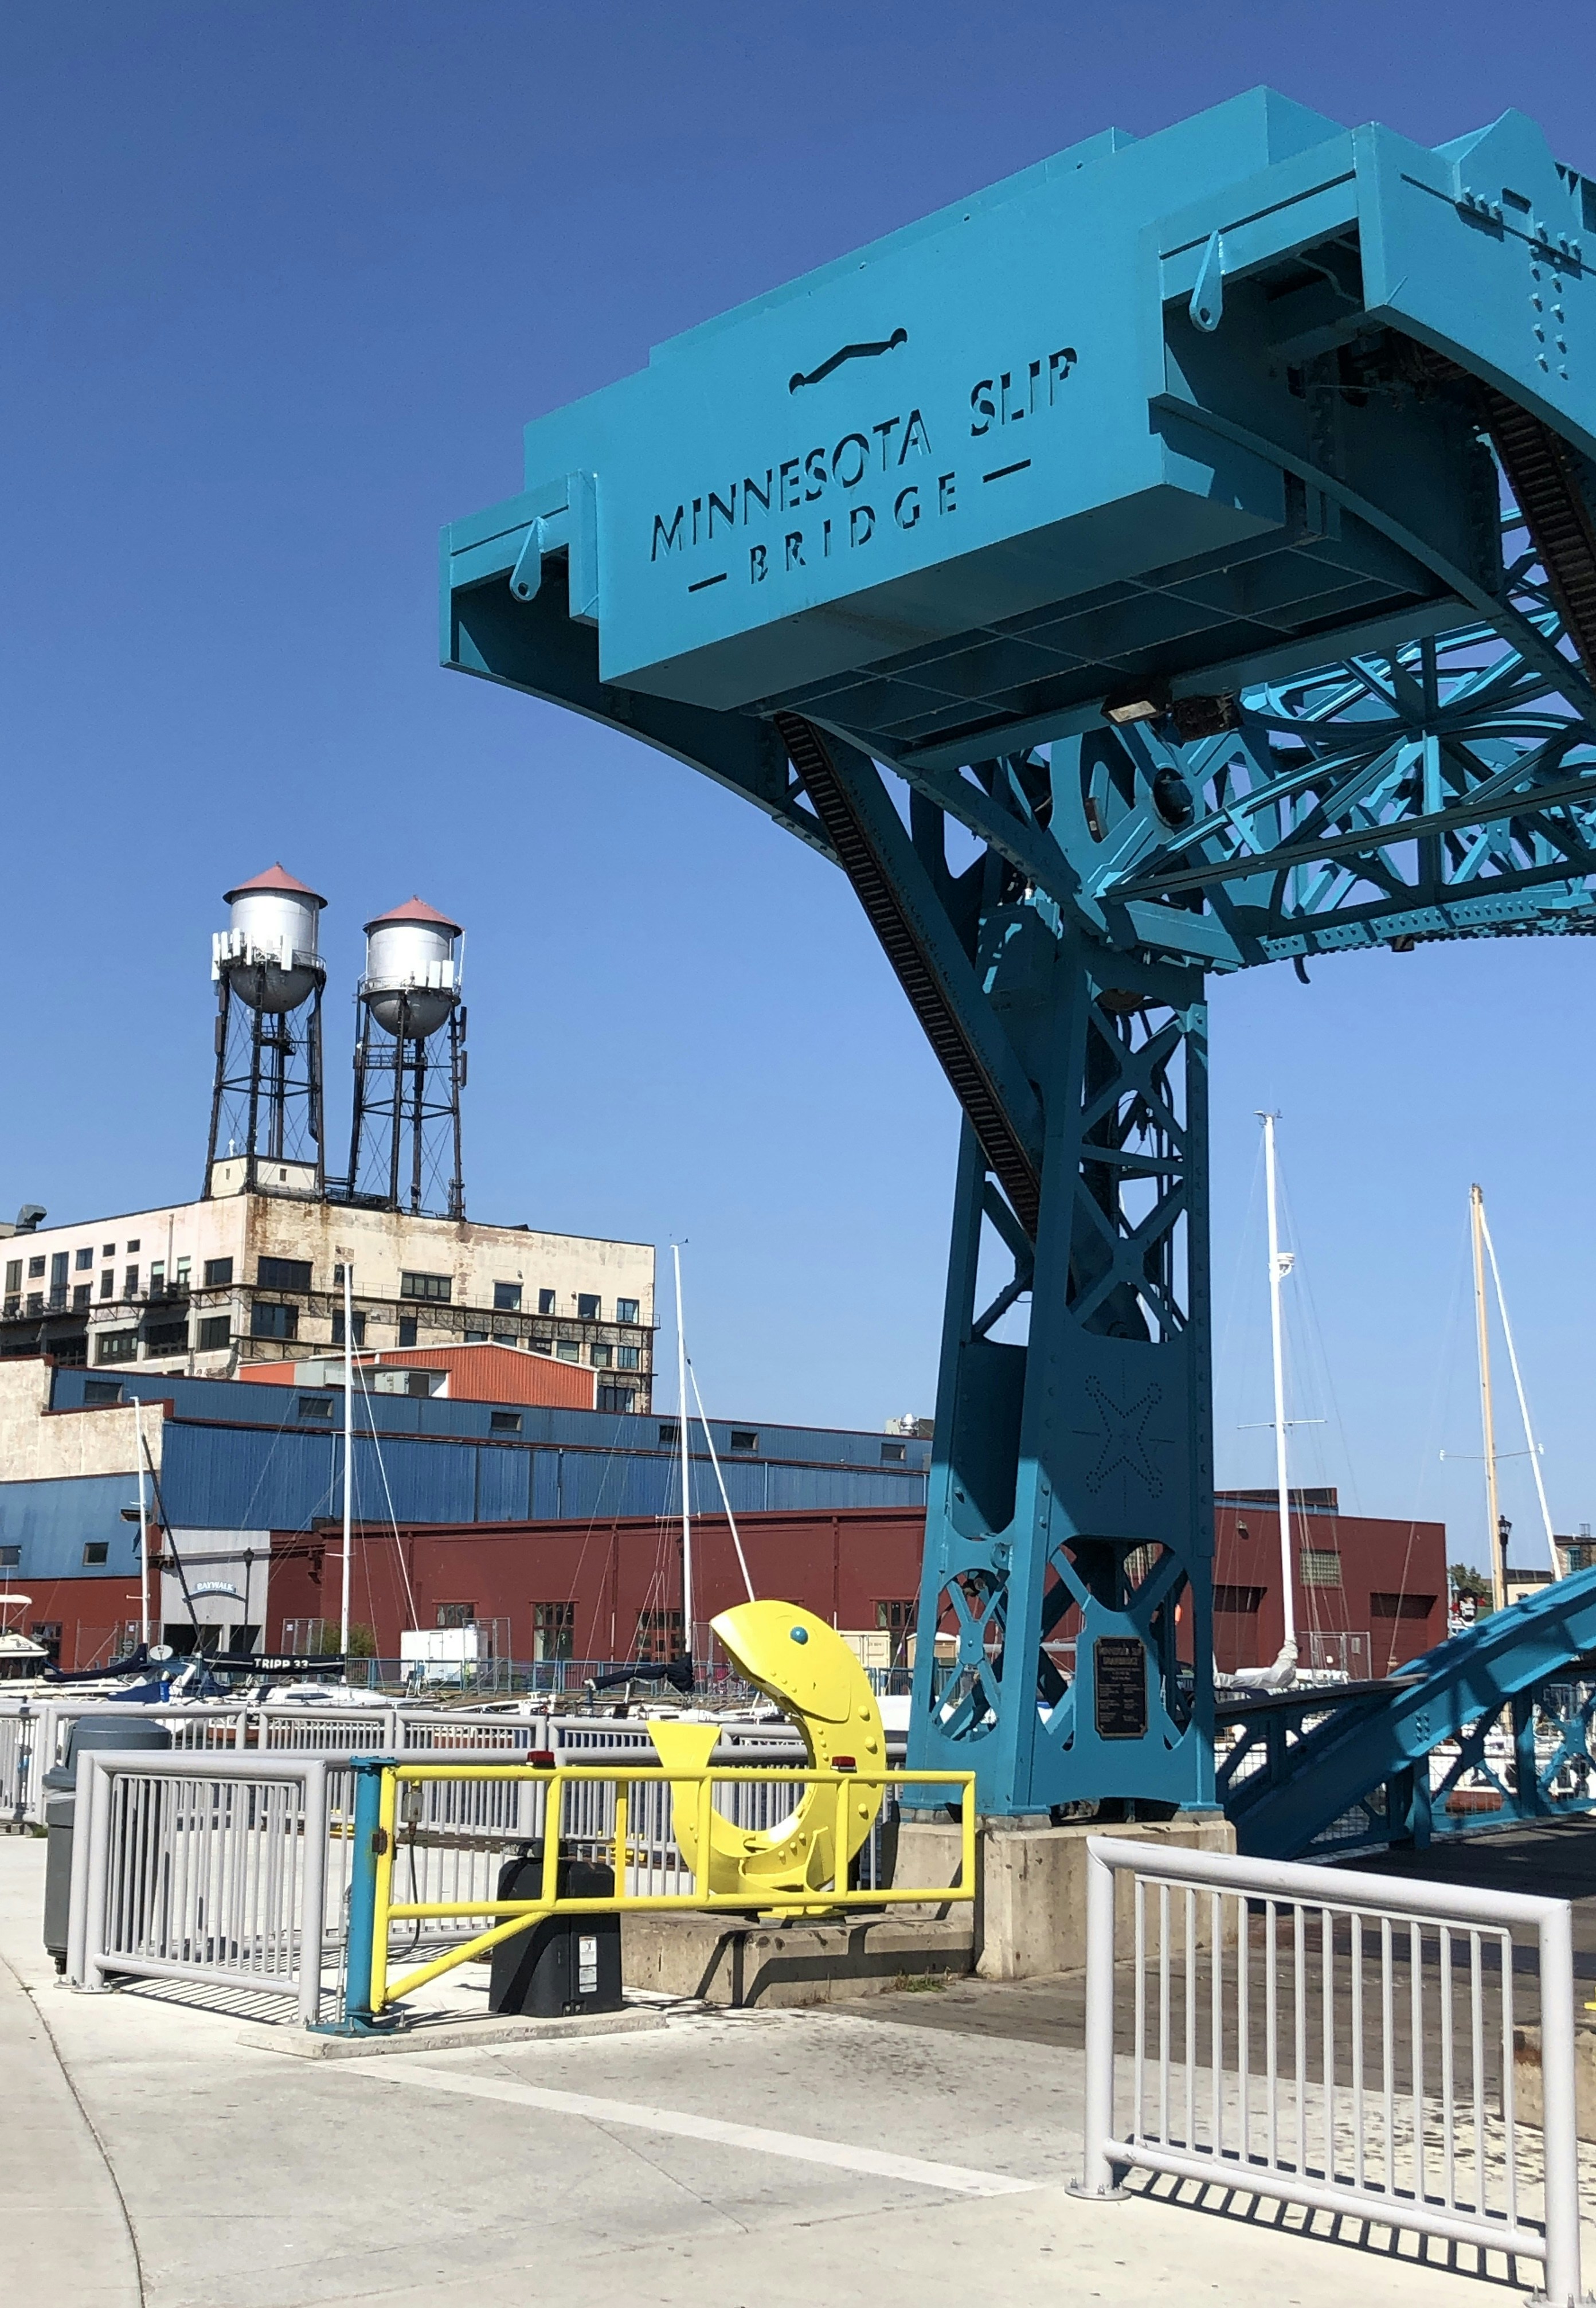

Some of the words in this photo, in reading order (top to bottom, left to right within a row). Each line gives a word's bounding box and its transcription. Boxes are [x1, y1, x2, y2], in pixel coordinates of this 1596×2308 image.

[651, 408, 932, 562] MINNESOTA
[969, 346, 1078, 437] SLIP
[749, 471, 957, 584] BRIDGE
[197, 1582, 234, 1591] BAYWALK
[253, 1658, 291, 1669] TRIPP
[293, 1659, 309, 1669] 33
